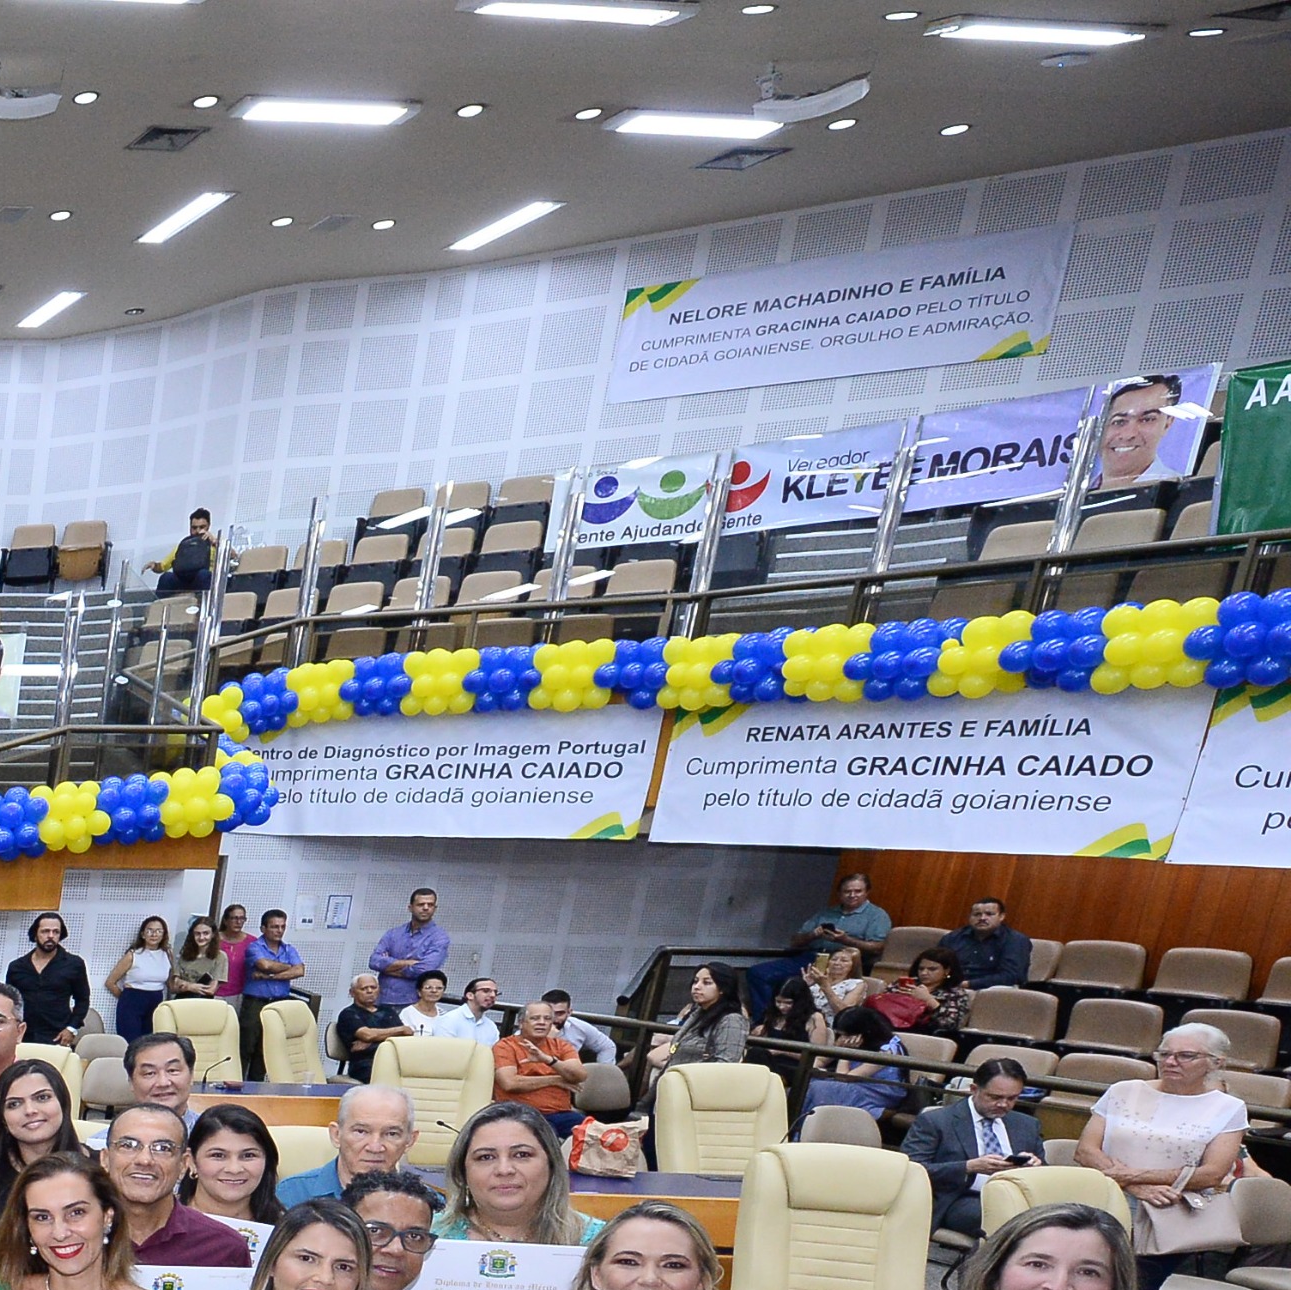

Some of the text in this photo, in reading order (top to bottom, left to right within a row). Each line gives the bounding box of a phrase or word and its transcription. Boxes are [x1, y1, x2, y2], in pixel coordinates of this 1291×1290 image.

[668, 266, 1006, 326] NELORE MACHADINHO E FAMÍLIA
[641, 289, 1030, 353] CUMPRIMENTA GRACINHA CAIADO PELO TÍTULO
[629, 310, 1034, 373] DE CIDADÃ GOIANIENSE. ORGULHO E ADMIRAÇÃO.
[746, 714, 1092, 743] RENATA ARANTES E FAMÍLIA
[298, 740, 646, 761] de Diagnóstico por Imagem Portugal
[385, 761, 623, 780] GRACINHA CAIADO
[685, 754, 1153, 779] Cumprimenta GRACINHA CAIADO
[309, 788, 594, 807] título de cidadã goianiense
[702, 787, 1112, 815] pelo título de cidadã goianiense
